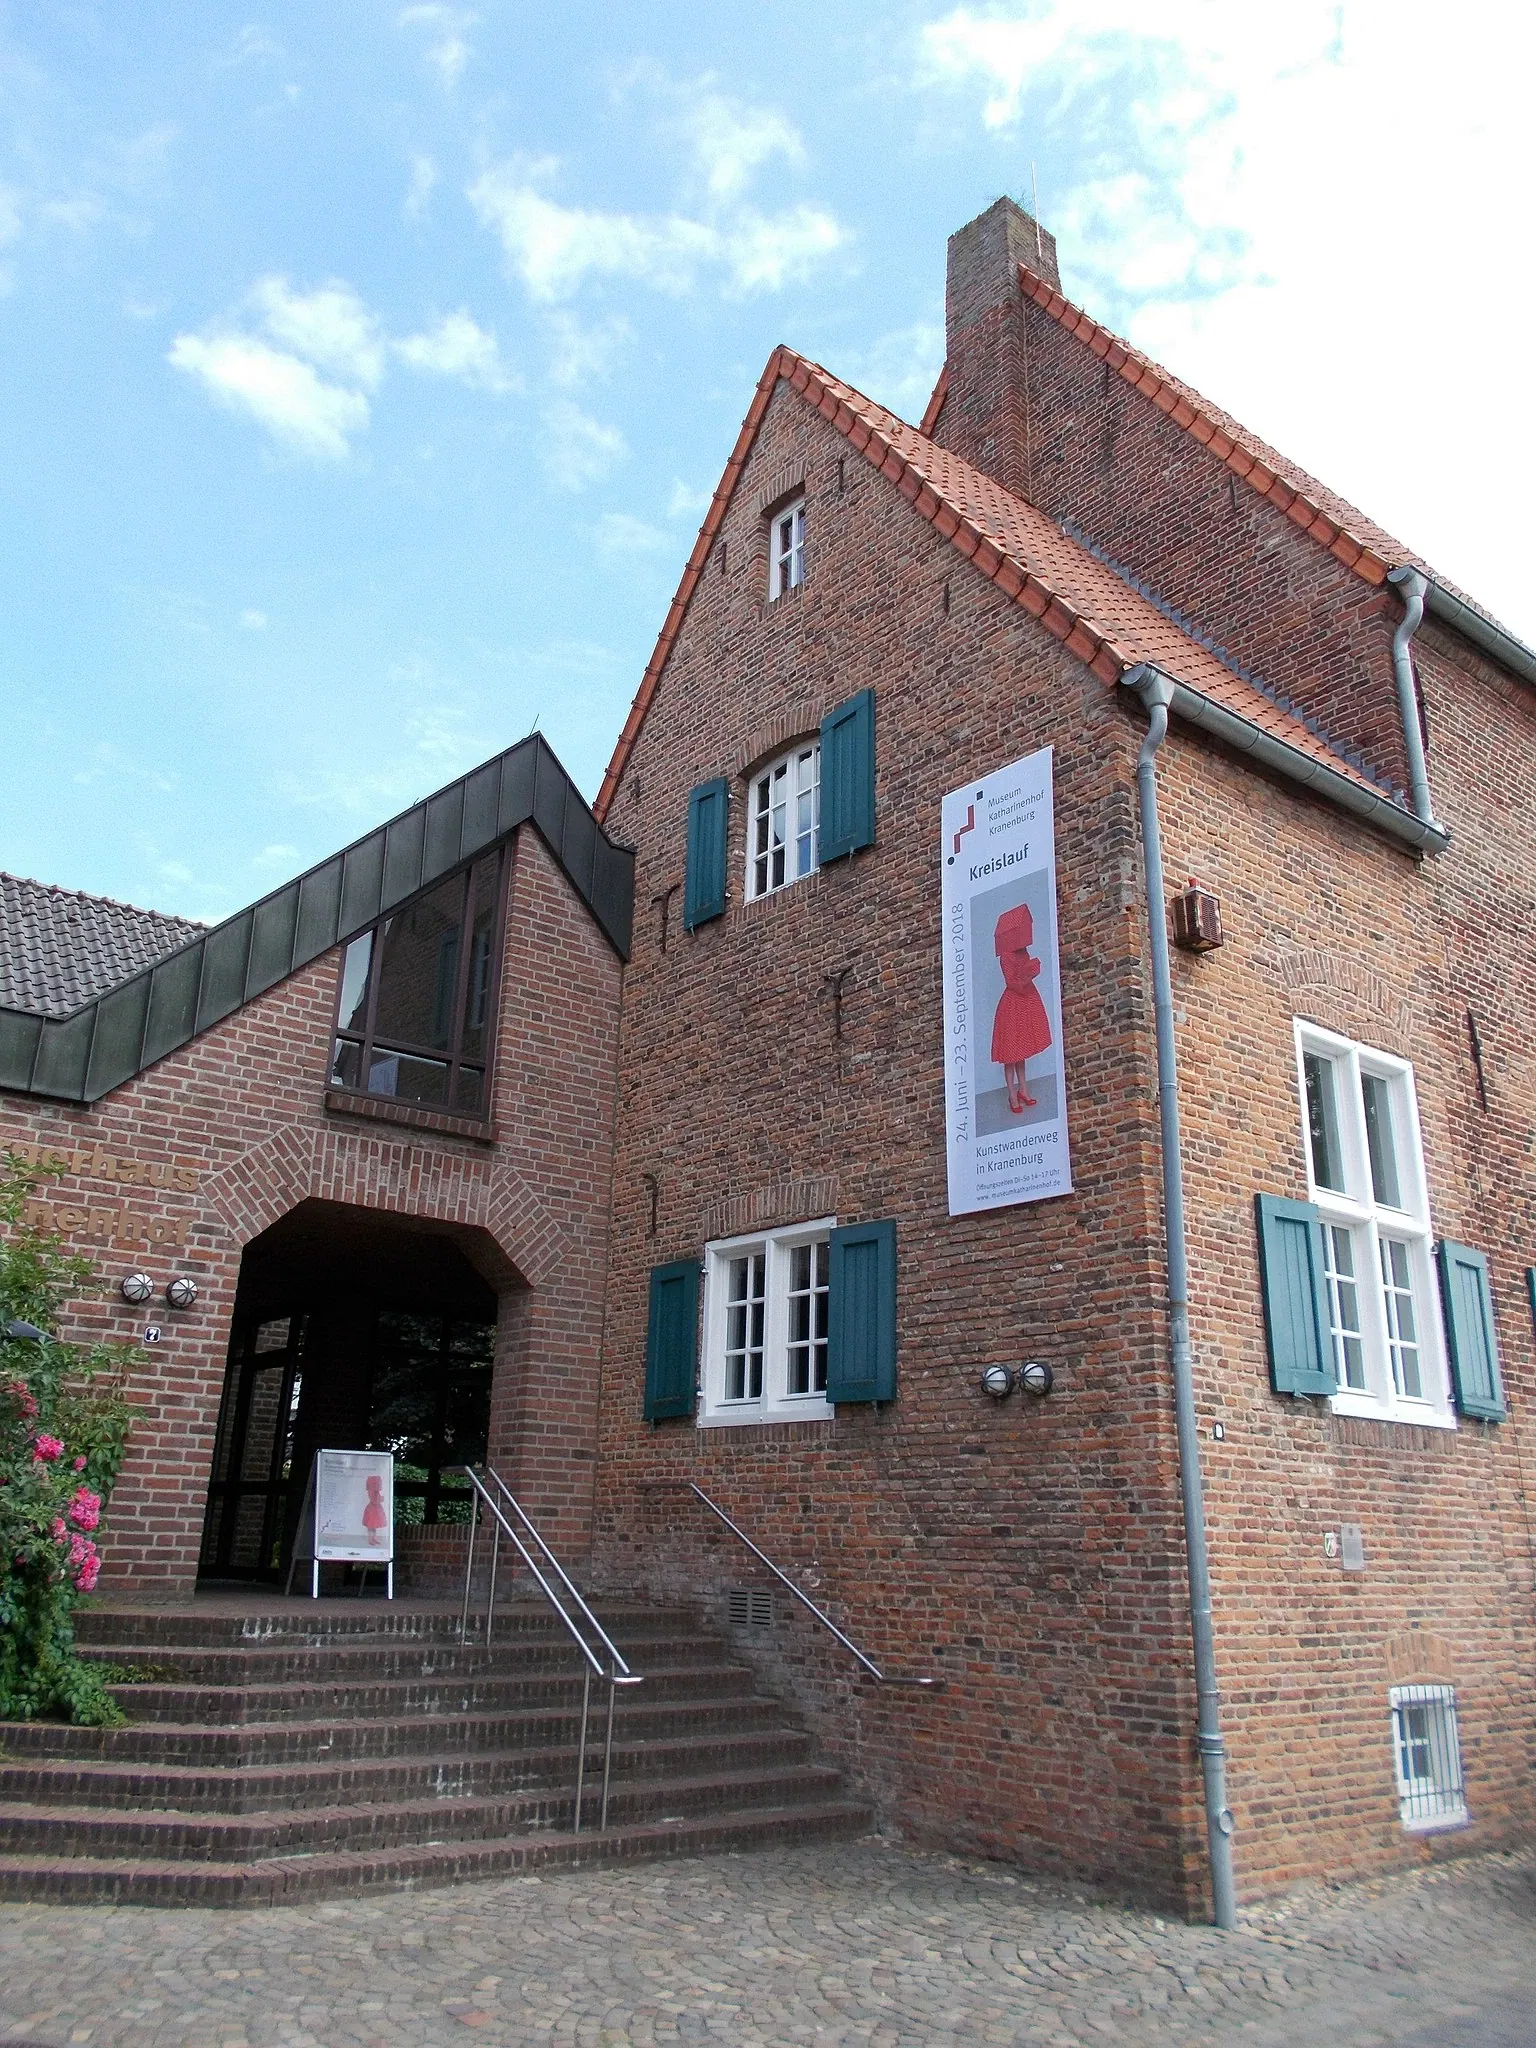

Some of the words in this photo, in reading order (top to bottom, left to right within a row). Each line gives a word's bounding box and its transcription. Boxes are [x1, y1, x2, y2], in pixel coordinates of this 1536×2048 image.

[988, 787, 1021, 808] Museum
[988, 789, 1045, 822] Katharinenhof
[989, 810, 1036, 836] Kranenburg
[970, 843, 1030, 881] Kreislauf
[951, 902, 964, 945] 2018
[952, 948, 969, 1035] September
[954, 1037, 967, 1065] 23.
[954, 1080, 970, 1112] Juni
[956, 1115, 968, 1143] 24.
[976, 1131, 1058, 1158] Kunstwanderweg
[976, 1163, 985, 1175] in
[987, 1151, 1044, 1174] Kranenburg
[1049, 1168, 1061, 1177] Uhr
